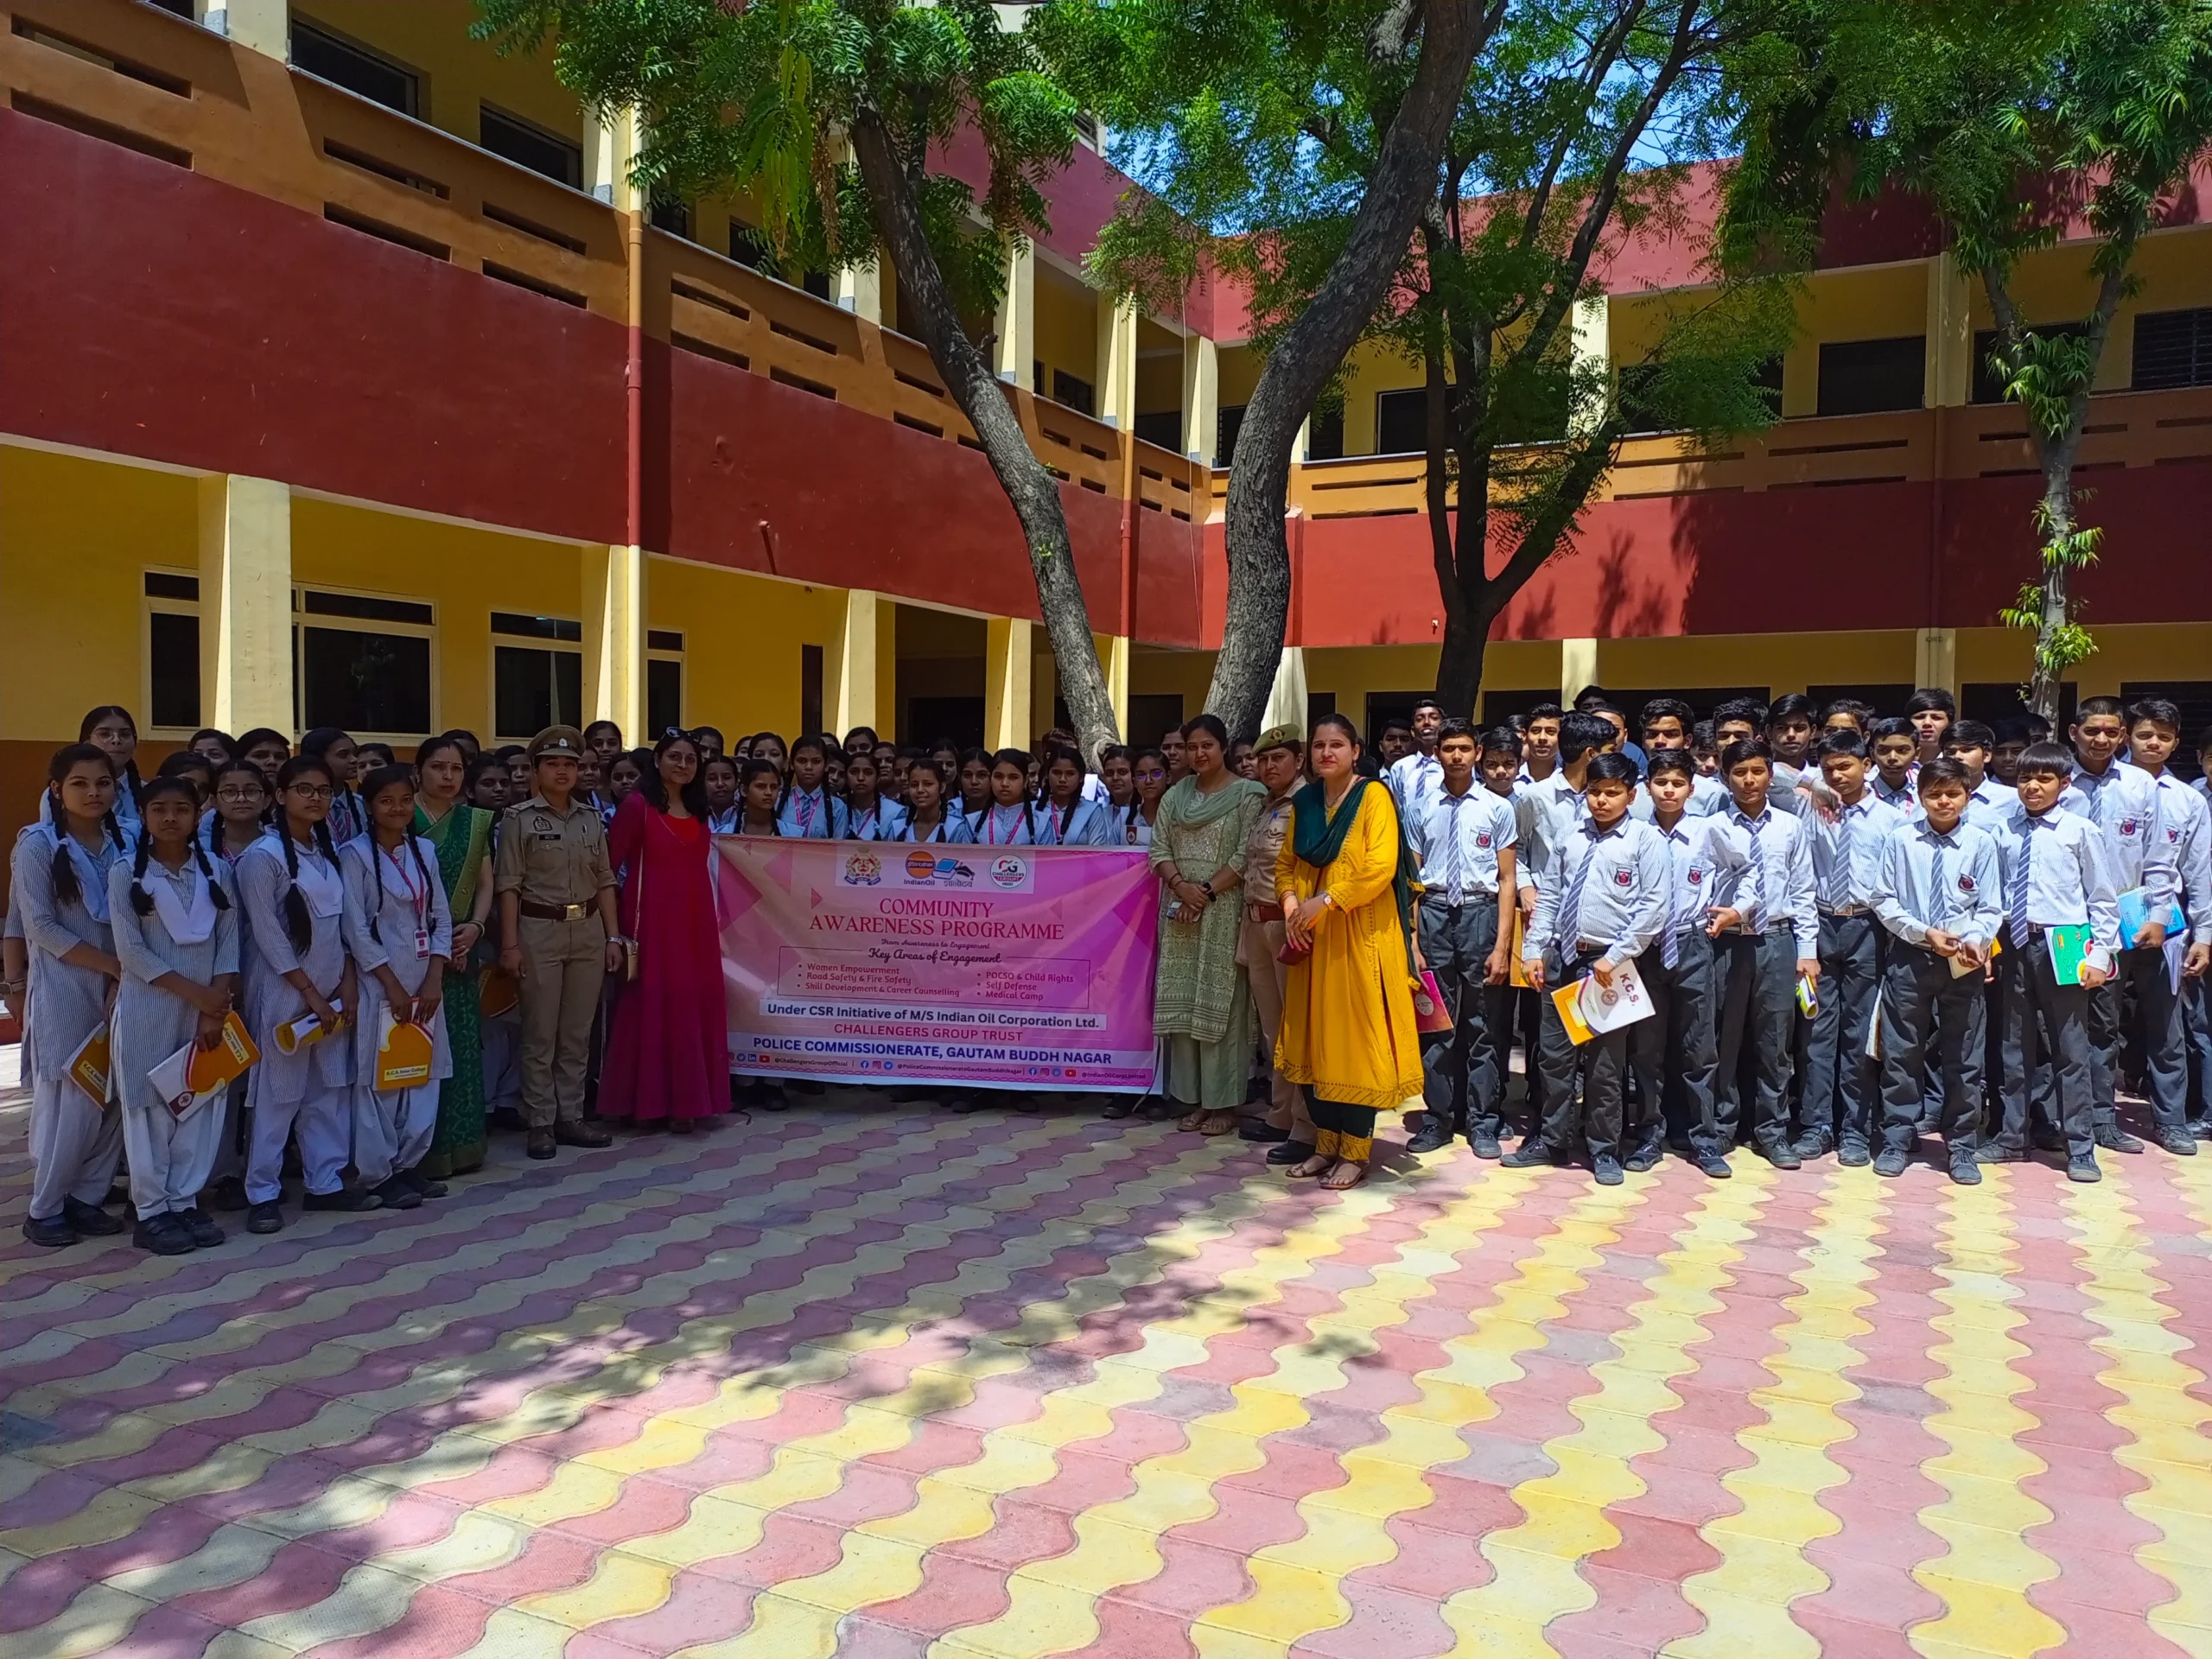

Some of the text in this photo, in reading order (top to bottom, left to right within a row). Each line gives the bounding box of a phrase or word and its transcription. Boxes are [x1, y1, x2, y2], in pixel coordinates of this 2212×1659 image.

[879, 898, 994, 918] COMMUNITY
[809, 914, 1065, 940] AWARENESS PROGRAMME
[950, 942, 990, 950] Engagement
[868, 947, 1002, 967] Key Areas of Engagement
[807, 963, 900, 975] Women Empowerment
[830, 973, 857, 983] Safety
[867, 975, 883, 983] Fire
[885, 976, 912, 985] Safety
[985, 971, 1014, 980] POCSO
[1025, 973, 1046, 982] Child
[1048, 974, 1074, 984] Rights
[824, 983, 877, 994] Development
[914, 987, 960, 998] Counselling
[1004, 982, 1037, 991] Defense
[1619, 973, 1639, 1006] K.C.S.
[985, 990, 1044, 1001] Medical Camp
[767, 1003, 1100, 1028] Under CSR Initiative of M/S Indian Oil Corporation Ltd.
[834, 1023, 1024, 1042] CHALLENGERS GROUP TRUST
[753, 1037, 1112, 1065] POLICE COMMISSIONERATE, GAUTAM BUDDH NAGAR
[774, 1058, 849, 1067] @ChallengersGroupOfficial
